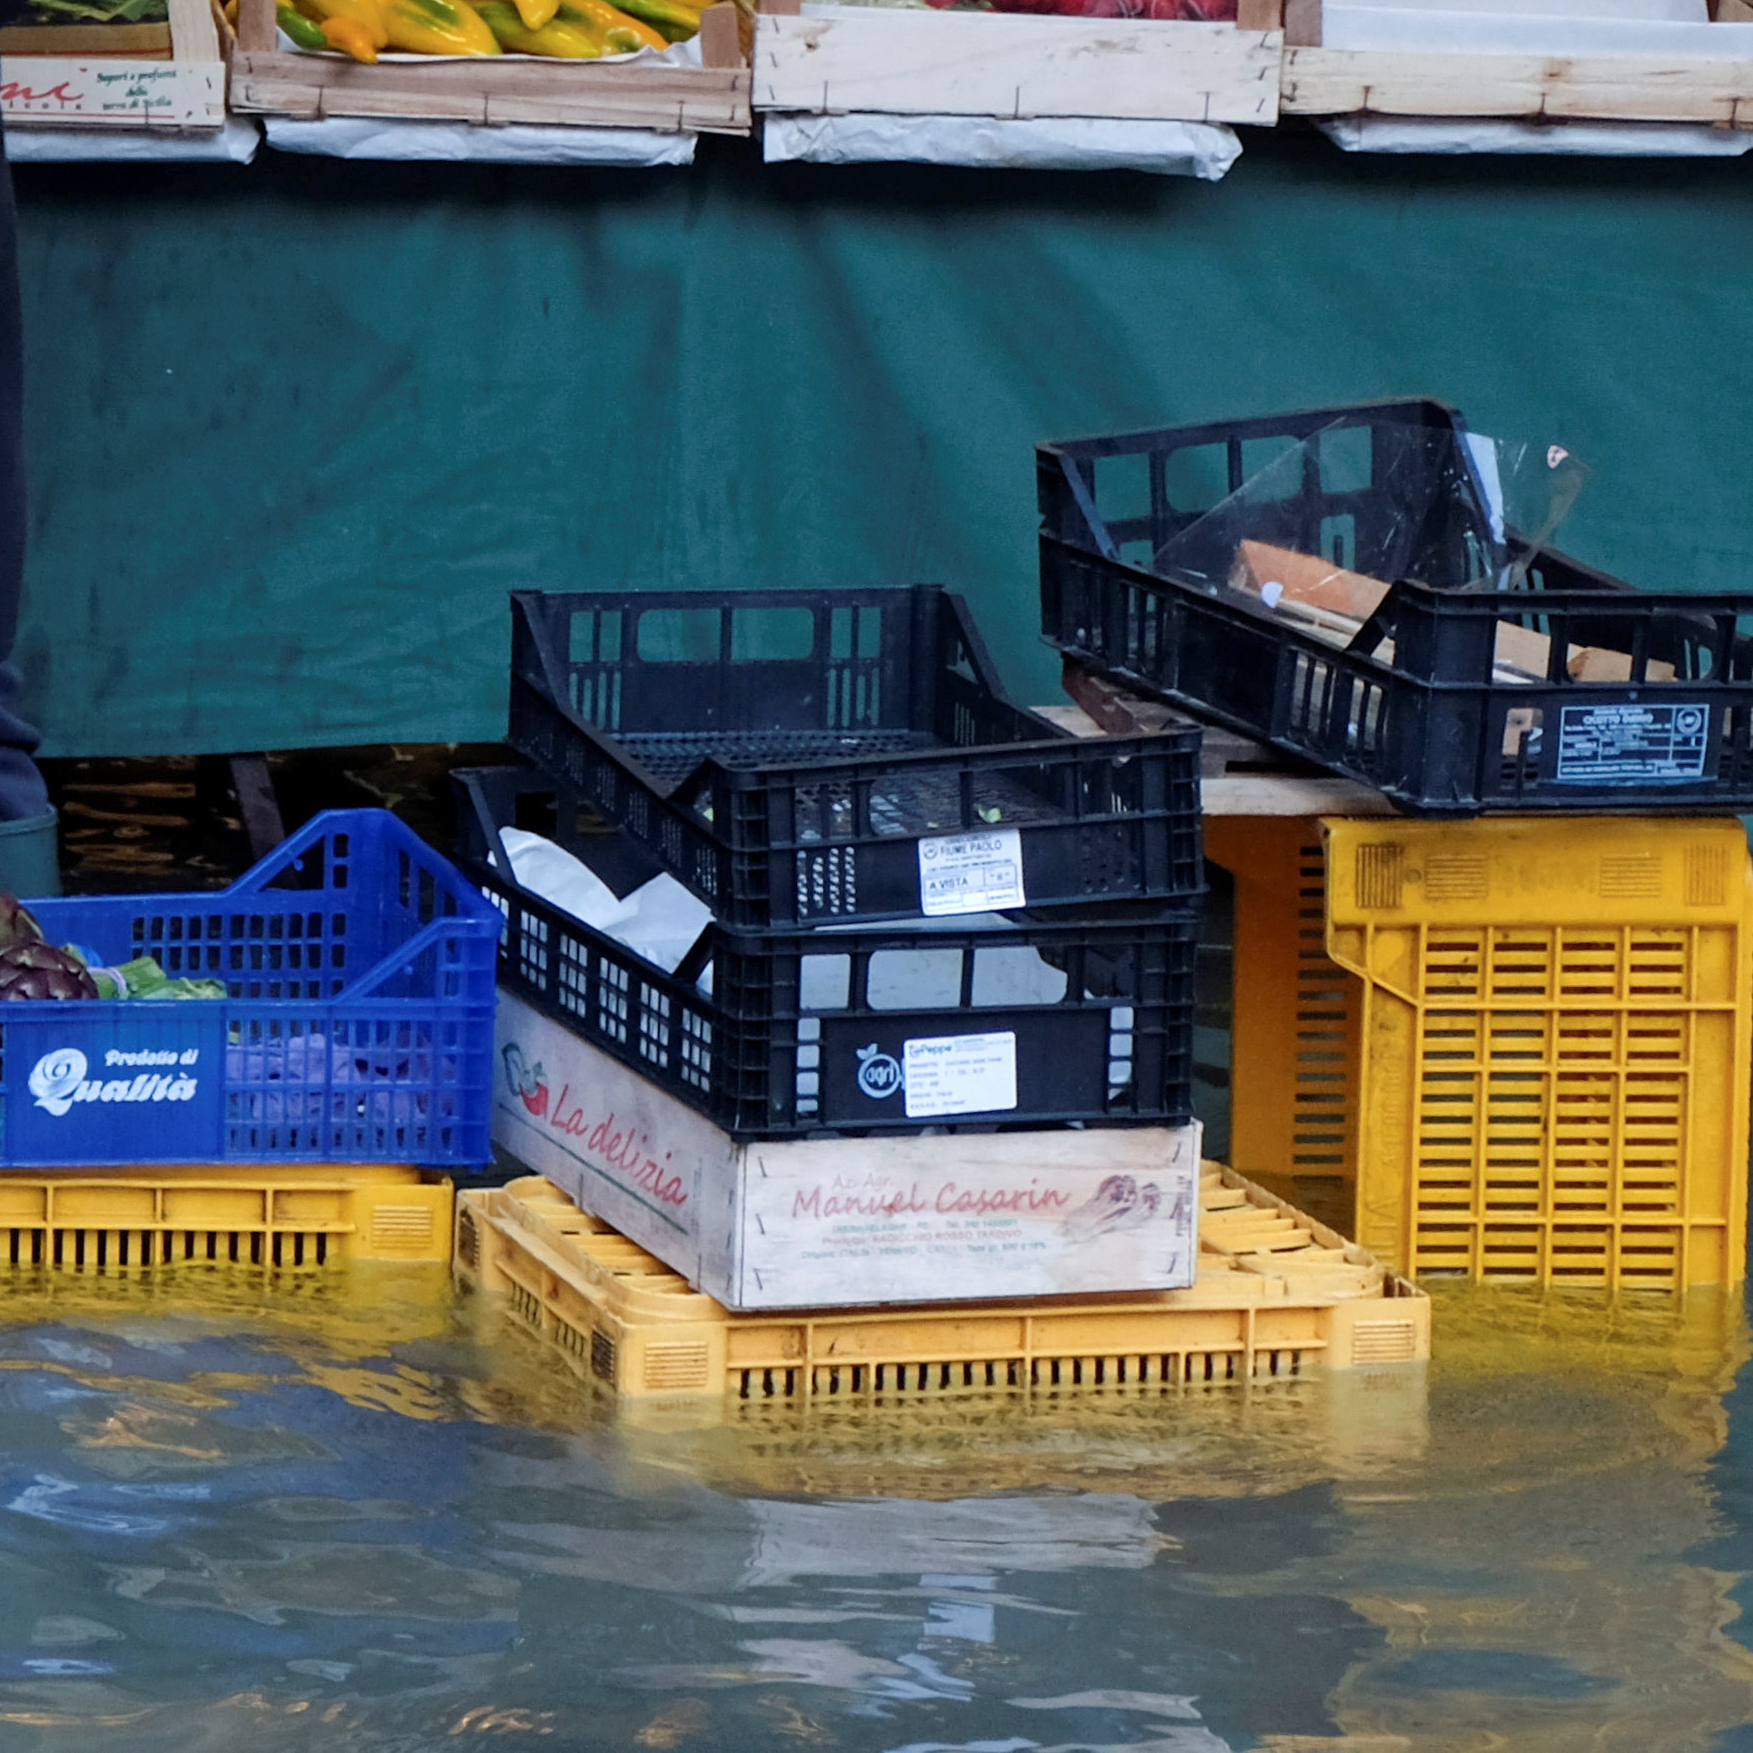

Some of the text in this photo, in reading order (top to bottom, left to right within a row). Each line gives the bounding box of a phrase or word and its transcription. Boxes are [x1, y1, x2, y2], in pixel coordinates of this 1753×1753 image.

[969, 838, 1003, 852] PAOLO
[104, 1047, 199, 1068] Prodotto di
[28, 1047, 198, 1117] Qualità
[550, 1082, 689, 1206] La delizia
[791, 1177, 1074, 1220] Manuel Casarin
